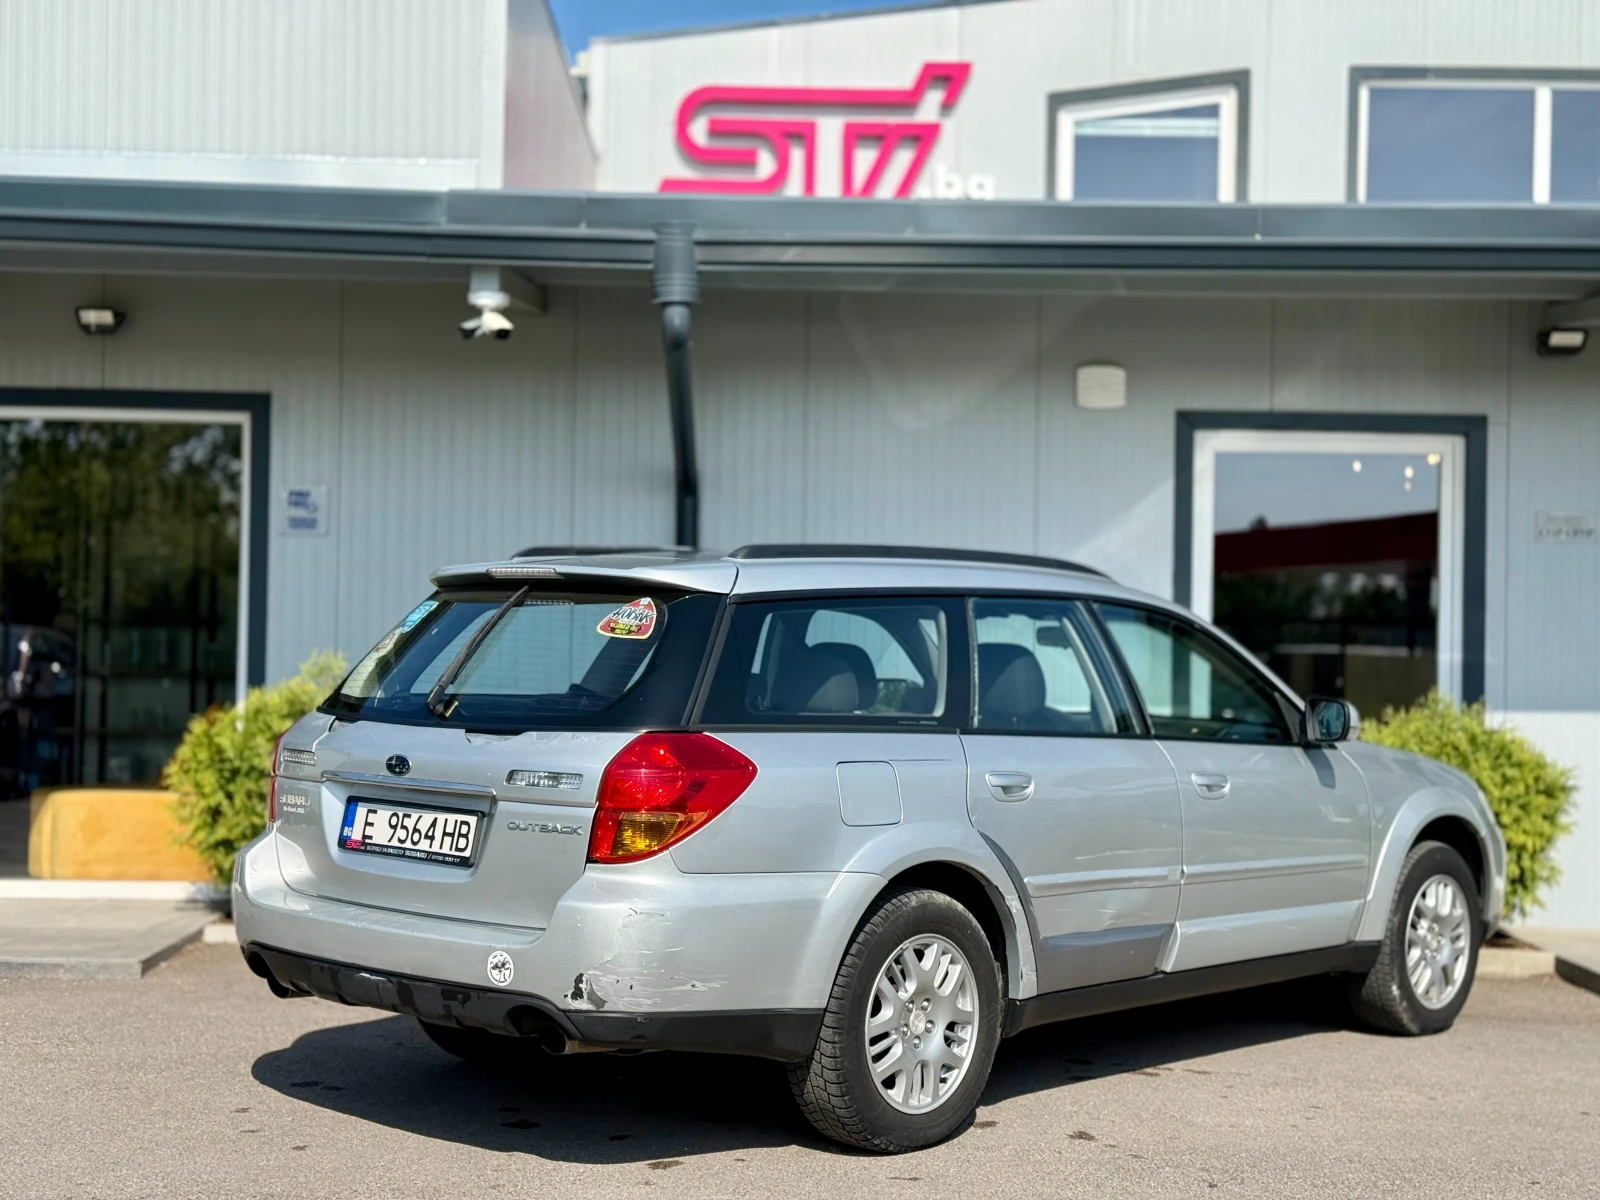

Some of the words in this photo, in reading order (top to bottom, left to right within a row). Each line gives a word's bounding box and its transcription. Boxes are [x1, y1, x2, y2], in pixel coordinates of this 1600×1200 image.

[279, 794, 311, 806] SUBARU
[342, 826, 353, 836] BG
[361, 808, 378, 843] E
[387, 811, 438, 849] 9564
[507, 821, 584, 836] OUTBACK
